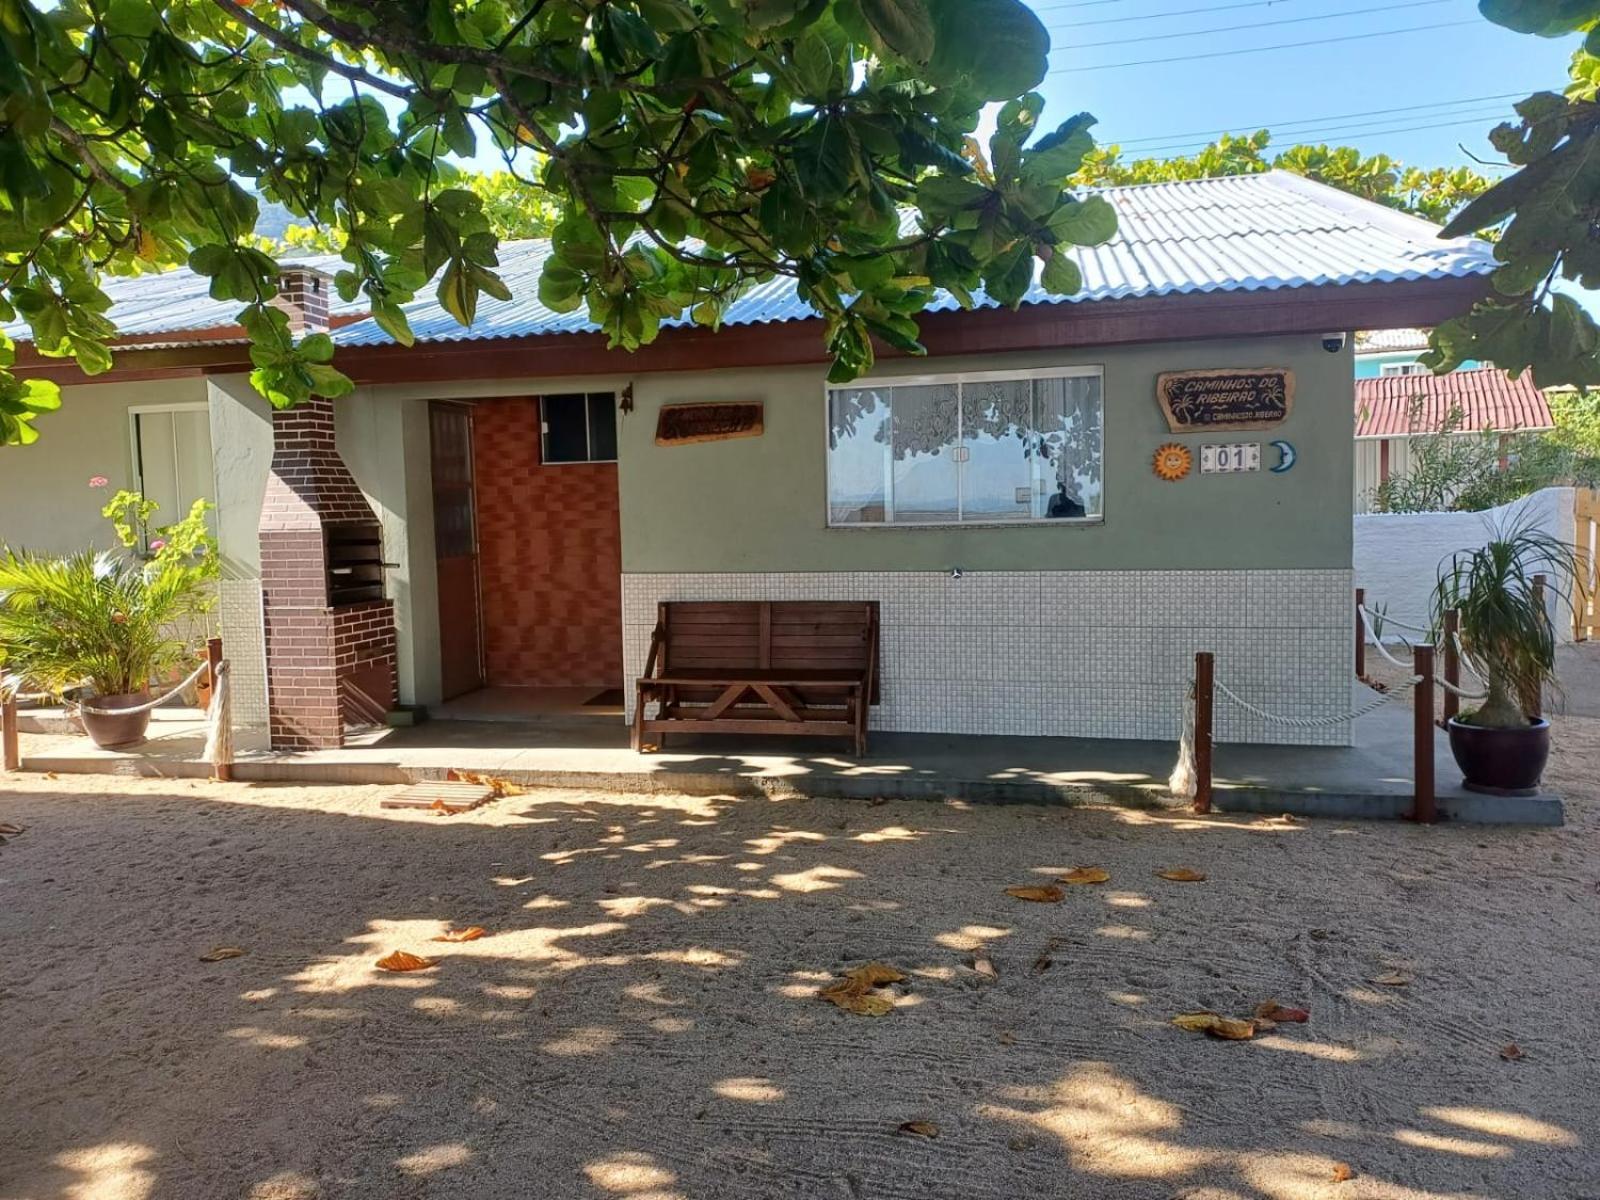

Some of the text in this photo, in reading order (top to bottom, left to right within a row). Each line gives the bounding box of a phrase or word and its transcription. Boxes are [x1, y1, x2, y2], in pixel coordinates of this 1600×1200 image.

[1184, 377, 1279, 393] CAMINHOS DO
[1218, 449, 1243, 467] 01
